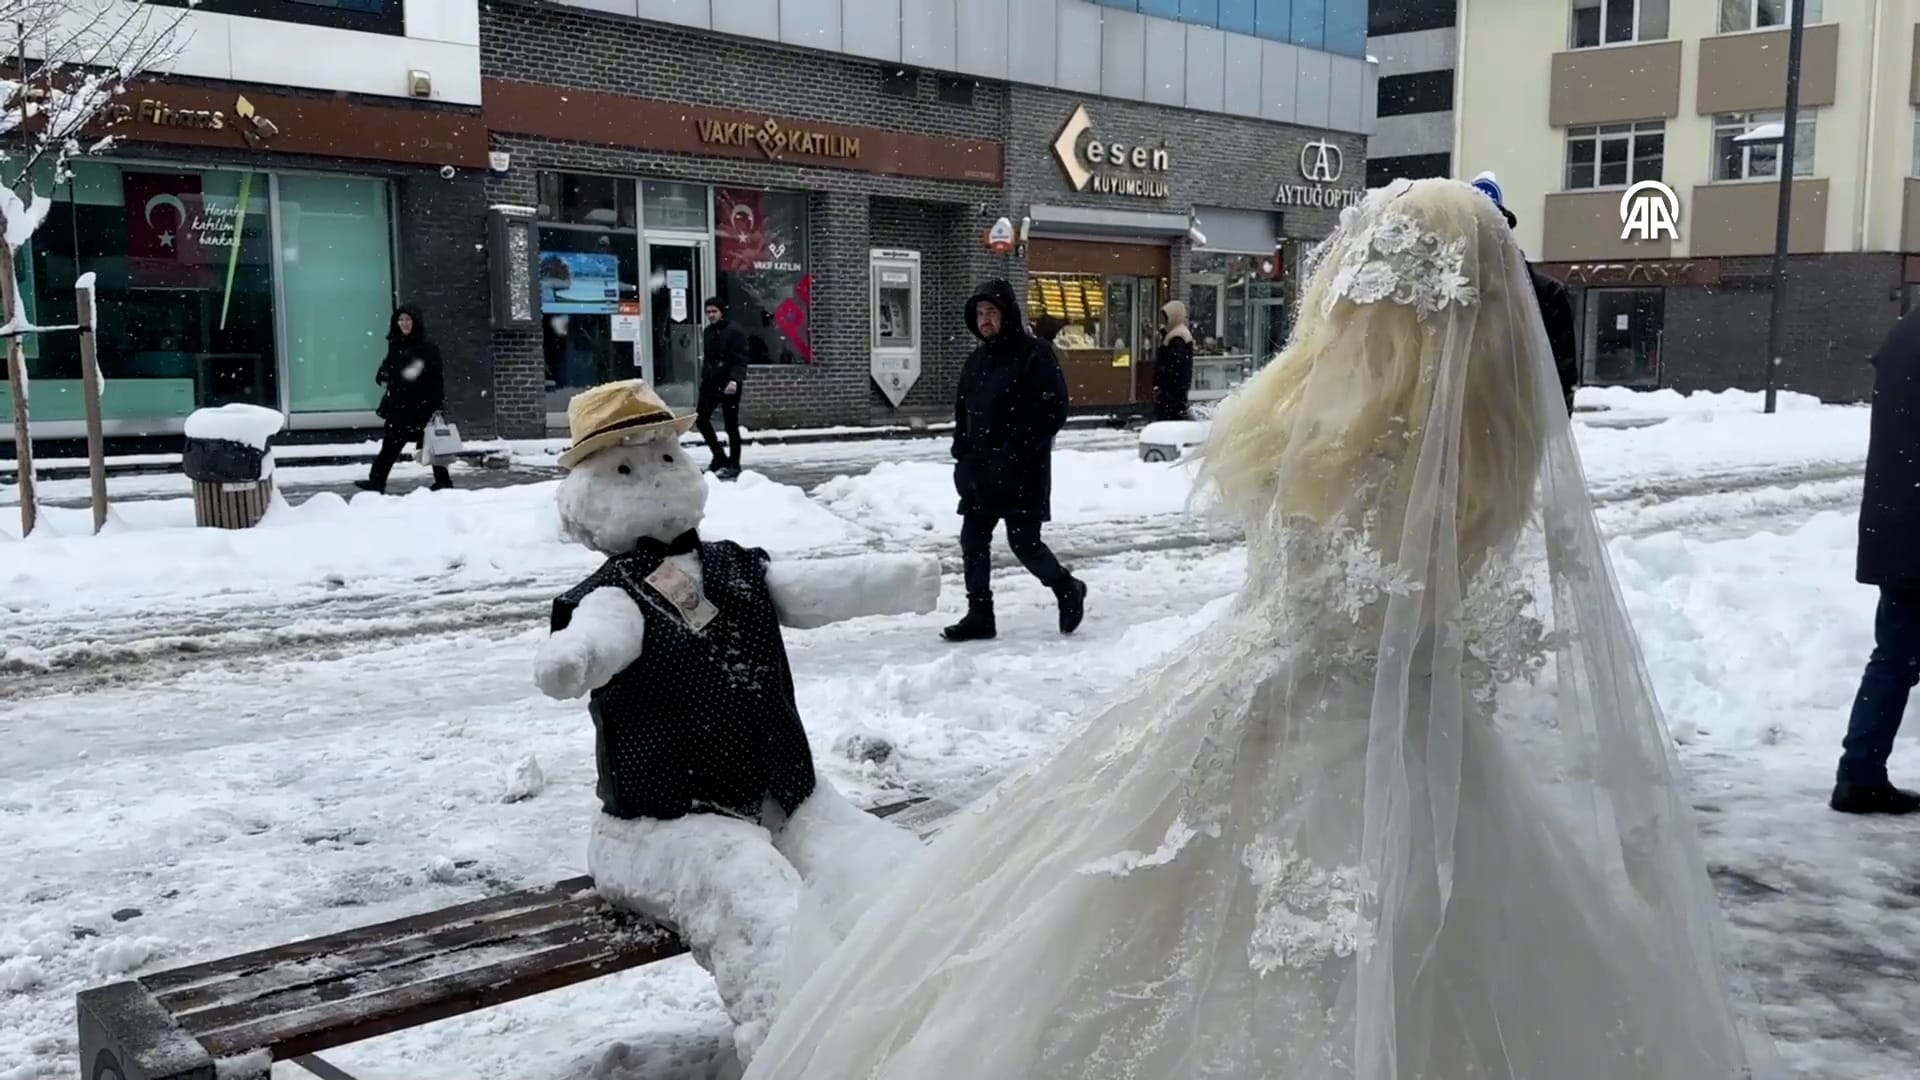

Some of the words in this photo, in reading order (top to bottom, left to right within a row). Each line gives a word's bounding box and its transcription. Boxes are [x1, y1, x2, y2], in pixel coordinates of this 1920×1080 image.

[137, 99, 225, 130] Finans
[697, 119, 755, 147] VAKIF
[788, 129, 860, 158] KATILIM
[1093, 175, 1169, 198] KUYUMCULUK
[1274, 183, 1323, 208] AYTUĞ
